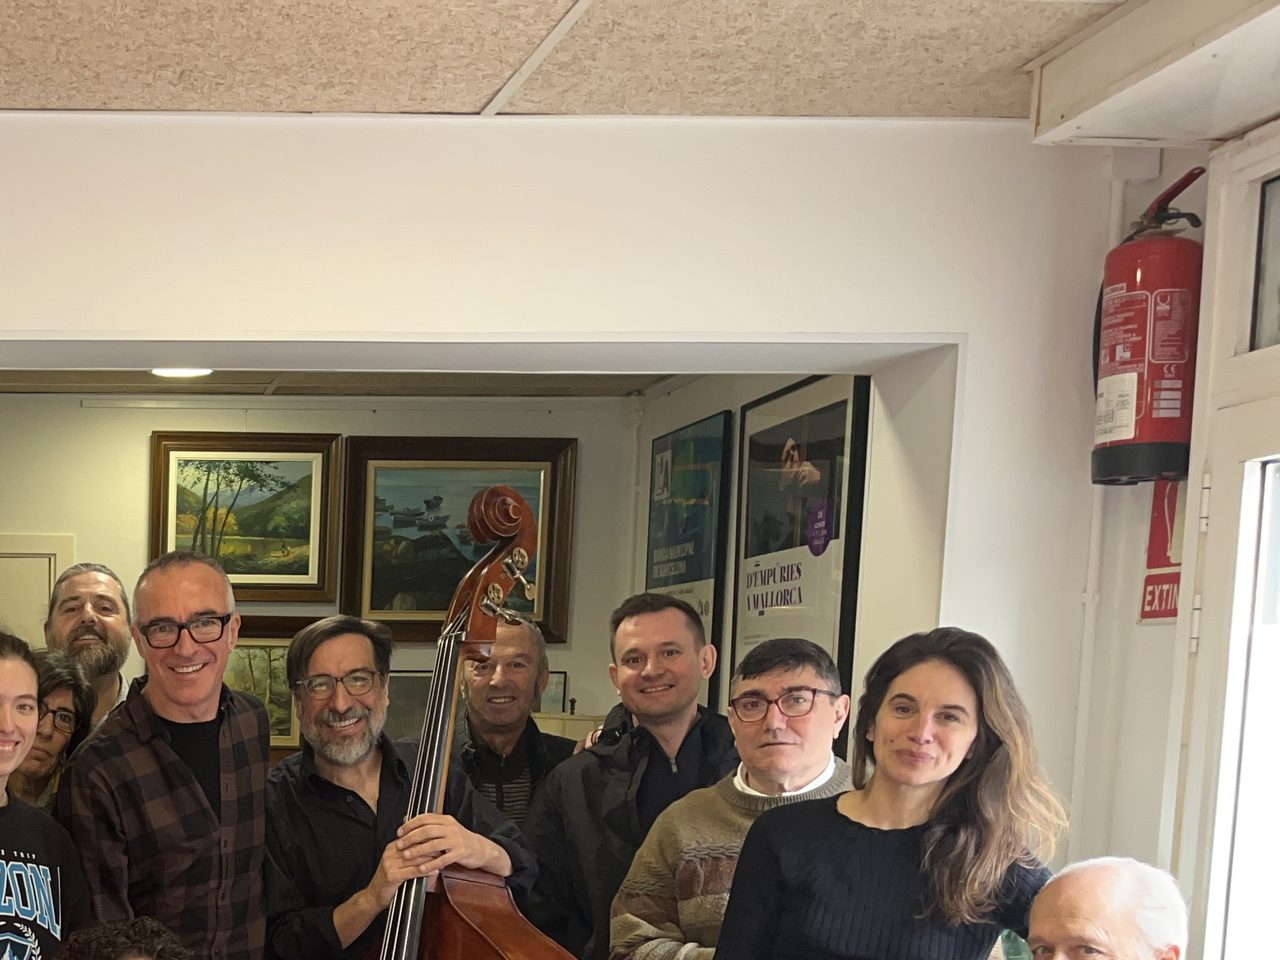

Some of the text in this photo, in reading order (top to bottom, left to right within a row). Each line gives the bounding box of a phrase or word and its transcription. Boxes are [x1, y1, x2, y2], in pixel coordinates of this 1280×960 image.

[746, 562, 802, 589] D'EMPÚRIES
[752, 587, 802, 610] MALLORCA
[1143, 583, 1179, 611] EXTIN
